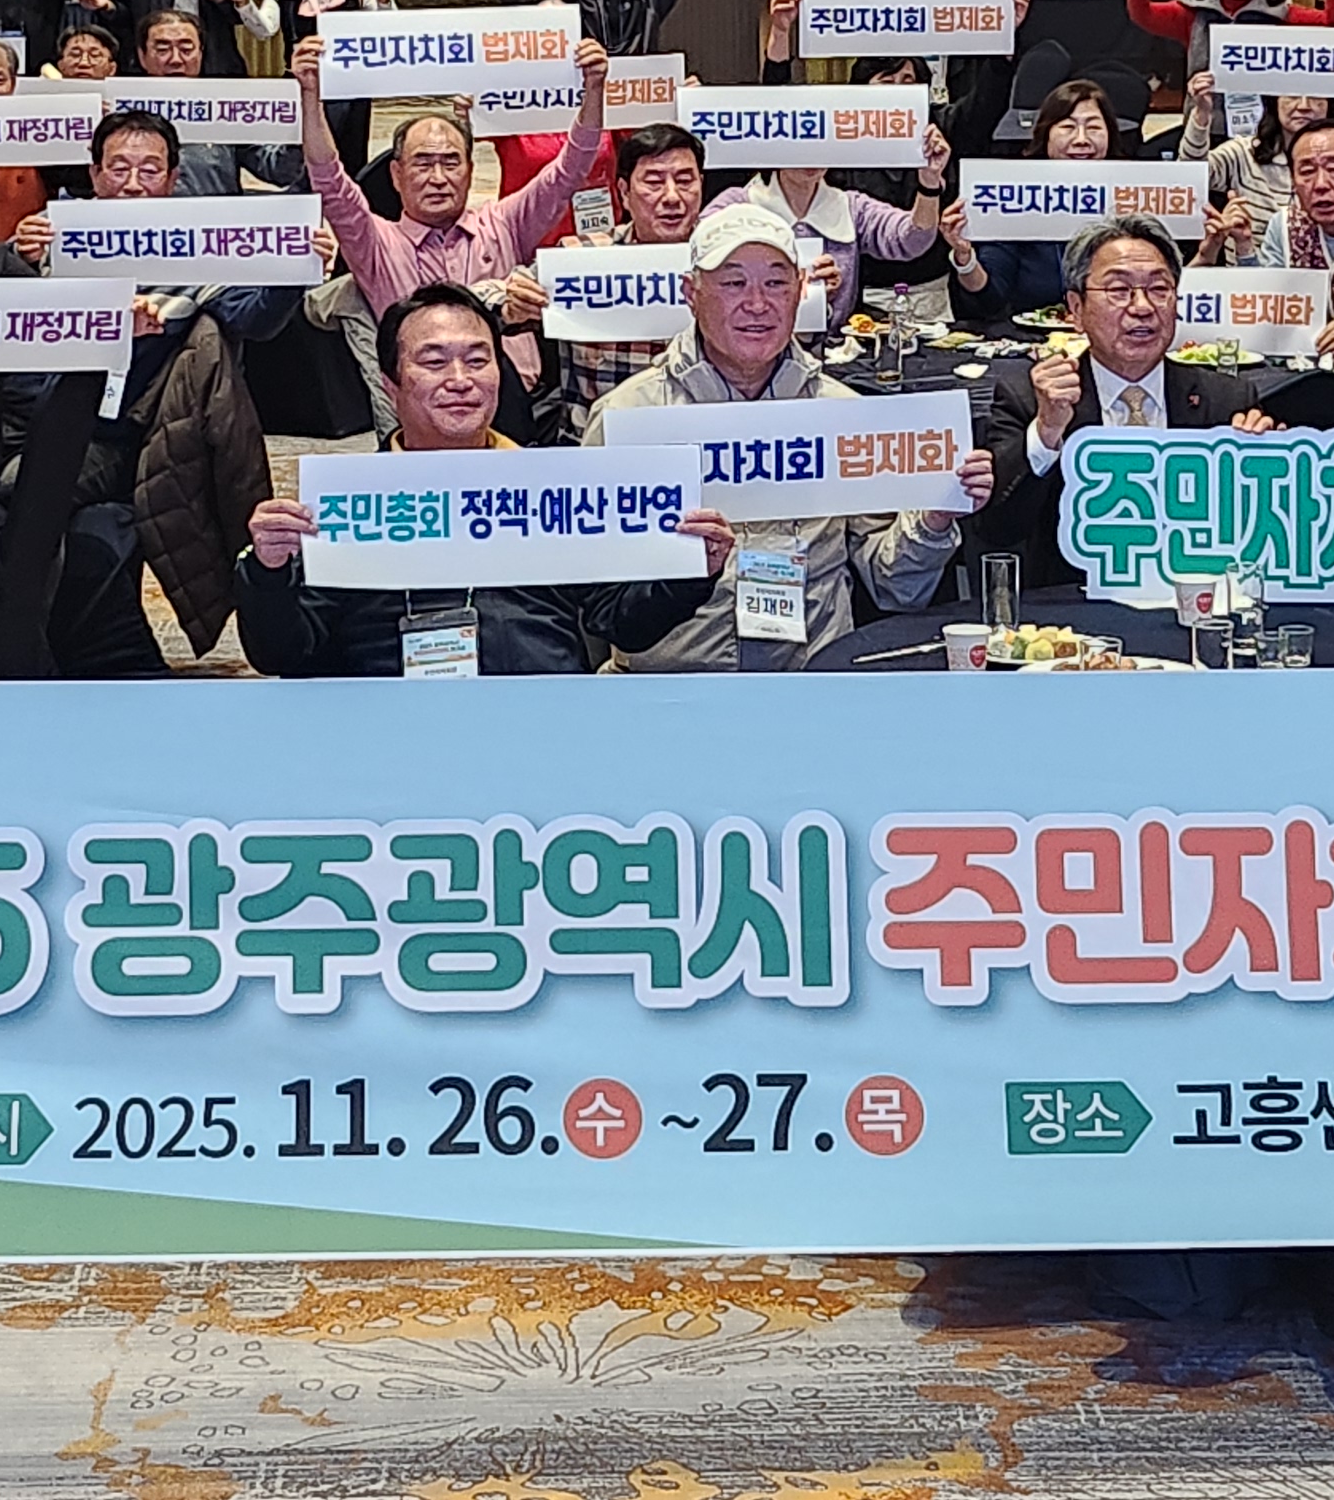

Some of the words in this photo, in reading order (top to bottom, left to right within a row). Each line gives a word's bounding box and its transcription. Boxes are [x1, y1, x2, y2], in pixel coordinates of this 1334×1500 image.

[810, 7, 926, 35] 주민자치회
[933, 7, 1004, 33] 법제화
[331, 32, 475, 68] 주민자치회
[482, 30, 568, 63] 법제화
[605, 77, 676, 107] 법제화
[6, 116, 94, 142] 재정자립
[217, 100, 297, 125] 재정자립
[691, 109, 826, 142] 주민자치회
[833, 108, 917, 141] 법제화
[972, 184, 1107, 215] 주민자치회
[1113, 184, 1196, 217] 법제화
[61, 227, 196, 259] 주민자치회
[202, 225, 311, 257] 재정자립
[554, 273, 689, 309] 주민자치
[5, 310, 123, 343] 재정자립
[1230, 293, 1315, 327] 법제화
[703, 436, 825, 485] 자치회
[836, 430, 959, 477] 법제화
[318, 490, 450, 545] 주민총회
[461, 487, 608, 540] 정책·예산
[616, 483, 684, 535] 반영
[82, 822, 835, 996] 광주광역시
[72, 1095, 256, 1161] 2025.
[276, 1078, 405, 1158] 11.
[573, 1091, 629, 1148] 수
[856, 1088, 911, 1145] 목
[1020, 1089, 1125, 1144] 장소
